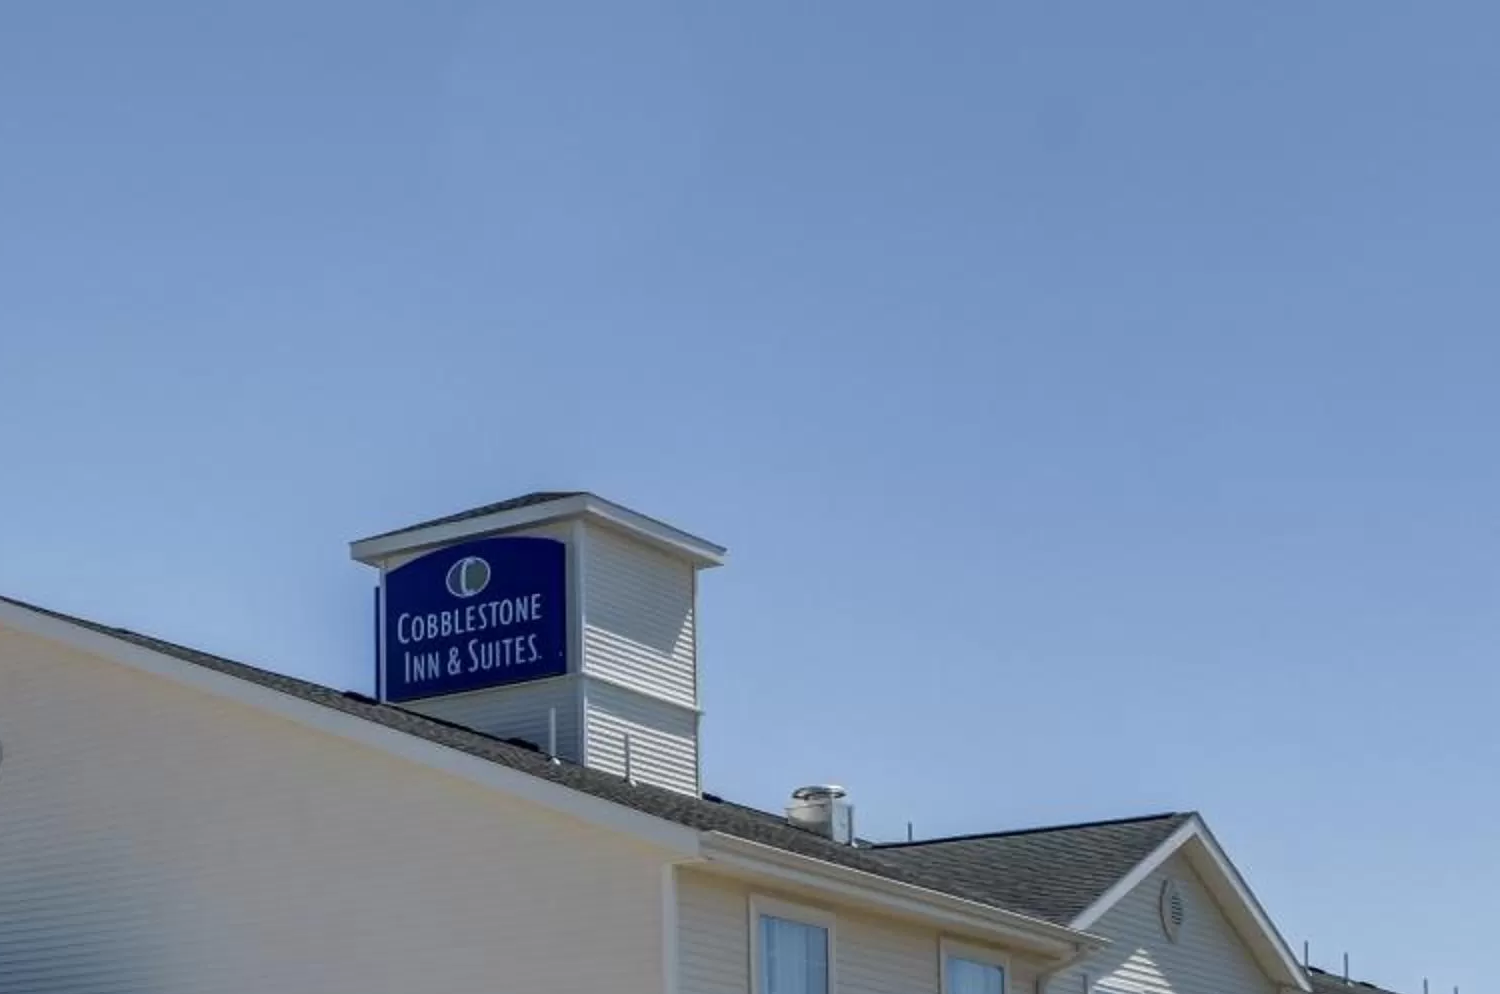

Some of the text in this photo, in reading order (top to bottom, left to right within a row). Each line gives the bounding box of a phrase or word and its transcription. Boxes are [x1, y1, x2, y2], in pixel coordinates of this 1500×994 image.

[397, 593, 543, 645] COBBLESTONE
[404, 651, 440, 684] INN
[447, 646, 462, 676] &
